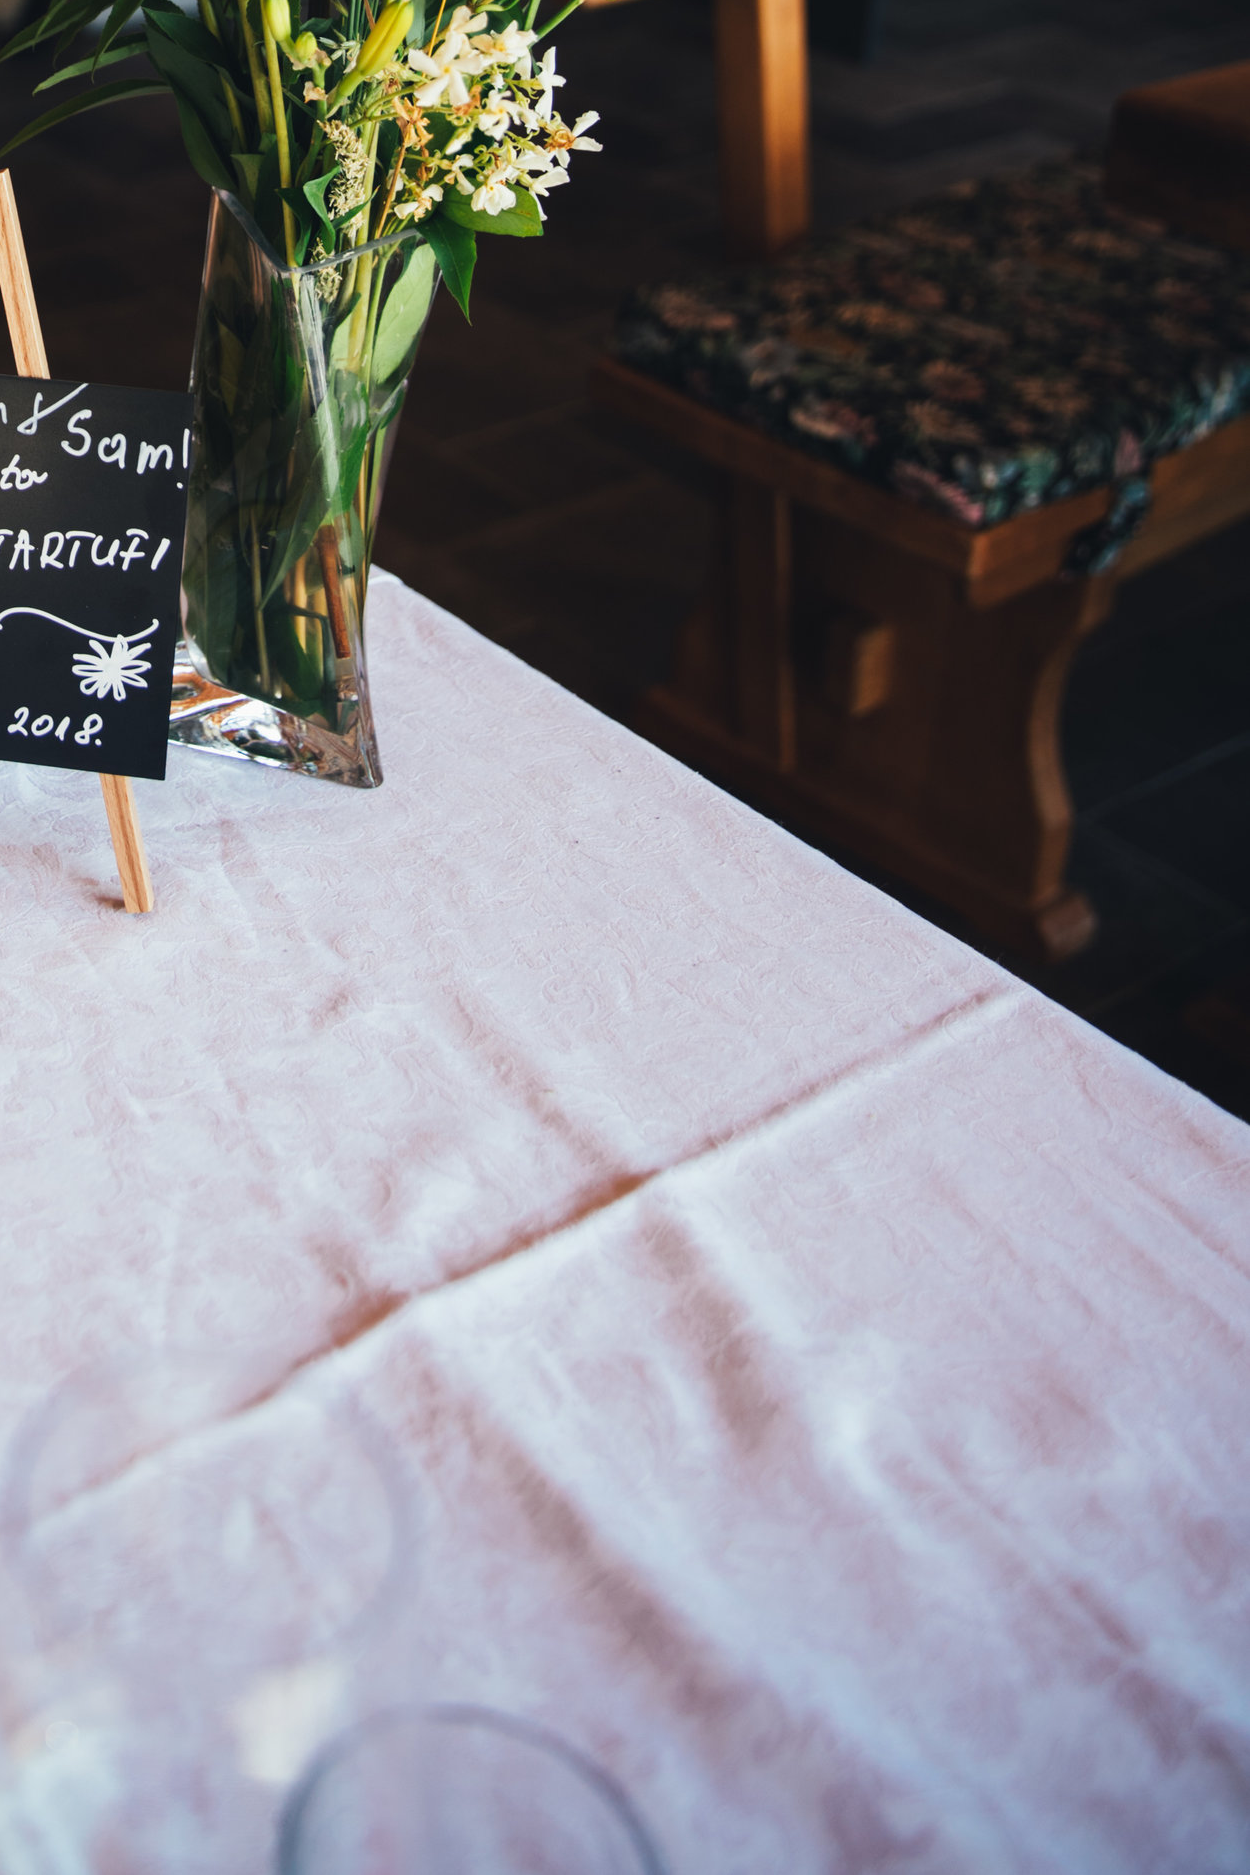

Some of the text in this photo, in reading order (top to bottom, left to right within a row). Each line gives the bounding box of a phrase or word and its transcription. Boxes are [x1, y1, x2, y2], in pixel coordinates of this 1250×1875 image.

[0, 454, 48, 490] to
[17, 382, 90, 434] &
[60, 409, 191, 490] Sam!
